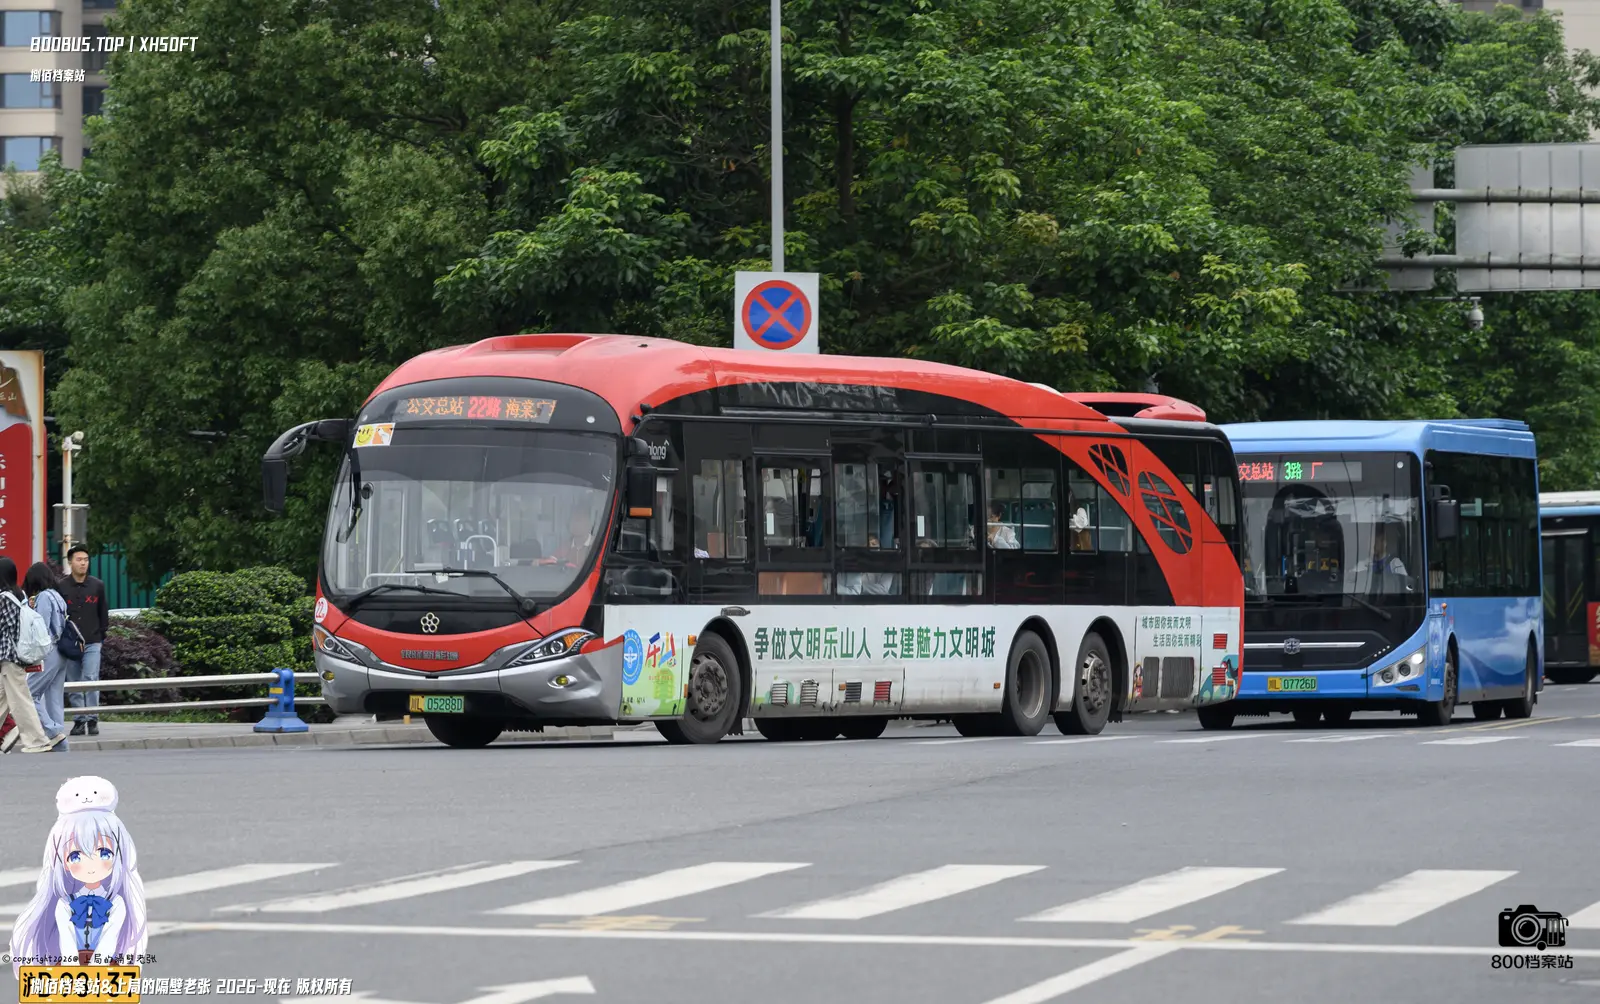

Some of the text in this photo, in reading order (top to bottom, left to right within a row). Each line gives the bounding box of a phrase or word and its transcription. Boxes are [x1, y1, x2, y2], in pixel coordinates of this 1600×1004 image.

[407, 397, 465, 417] 公交总站
[467, 396, 502, 418] 22路
[1284, 461, 1303, 480] 3路
[1142, 616, 1192, 630] 城市因你我而文明
[754, 626, 996, 660] 争做文明乐山人 共建魅力文明城
[1152, 633, 1202, 648] 生活因你我而精彩
